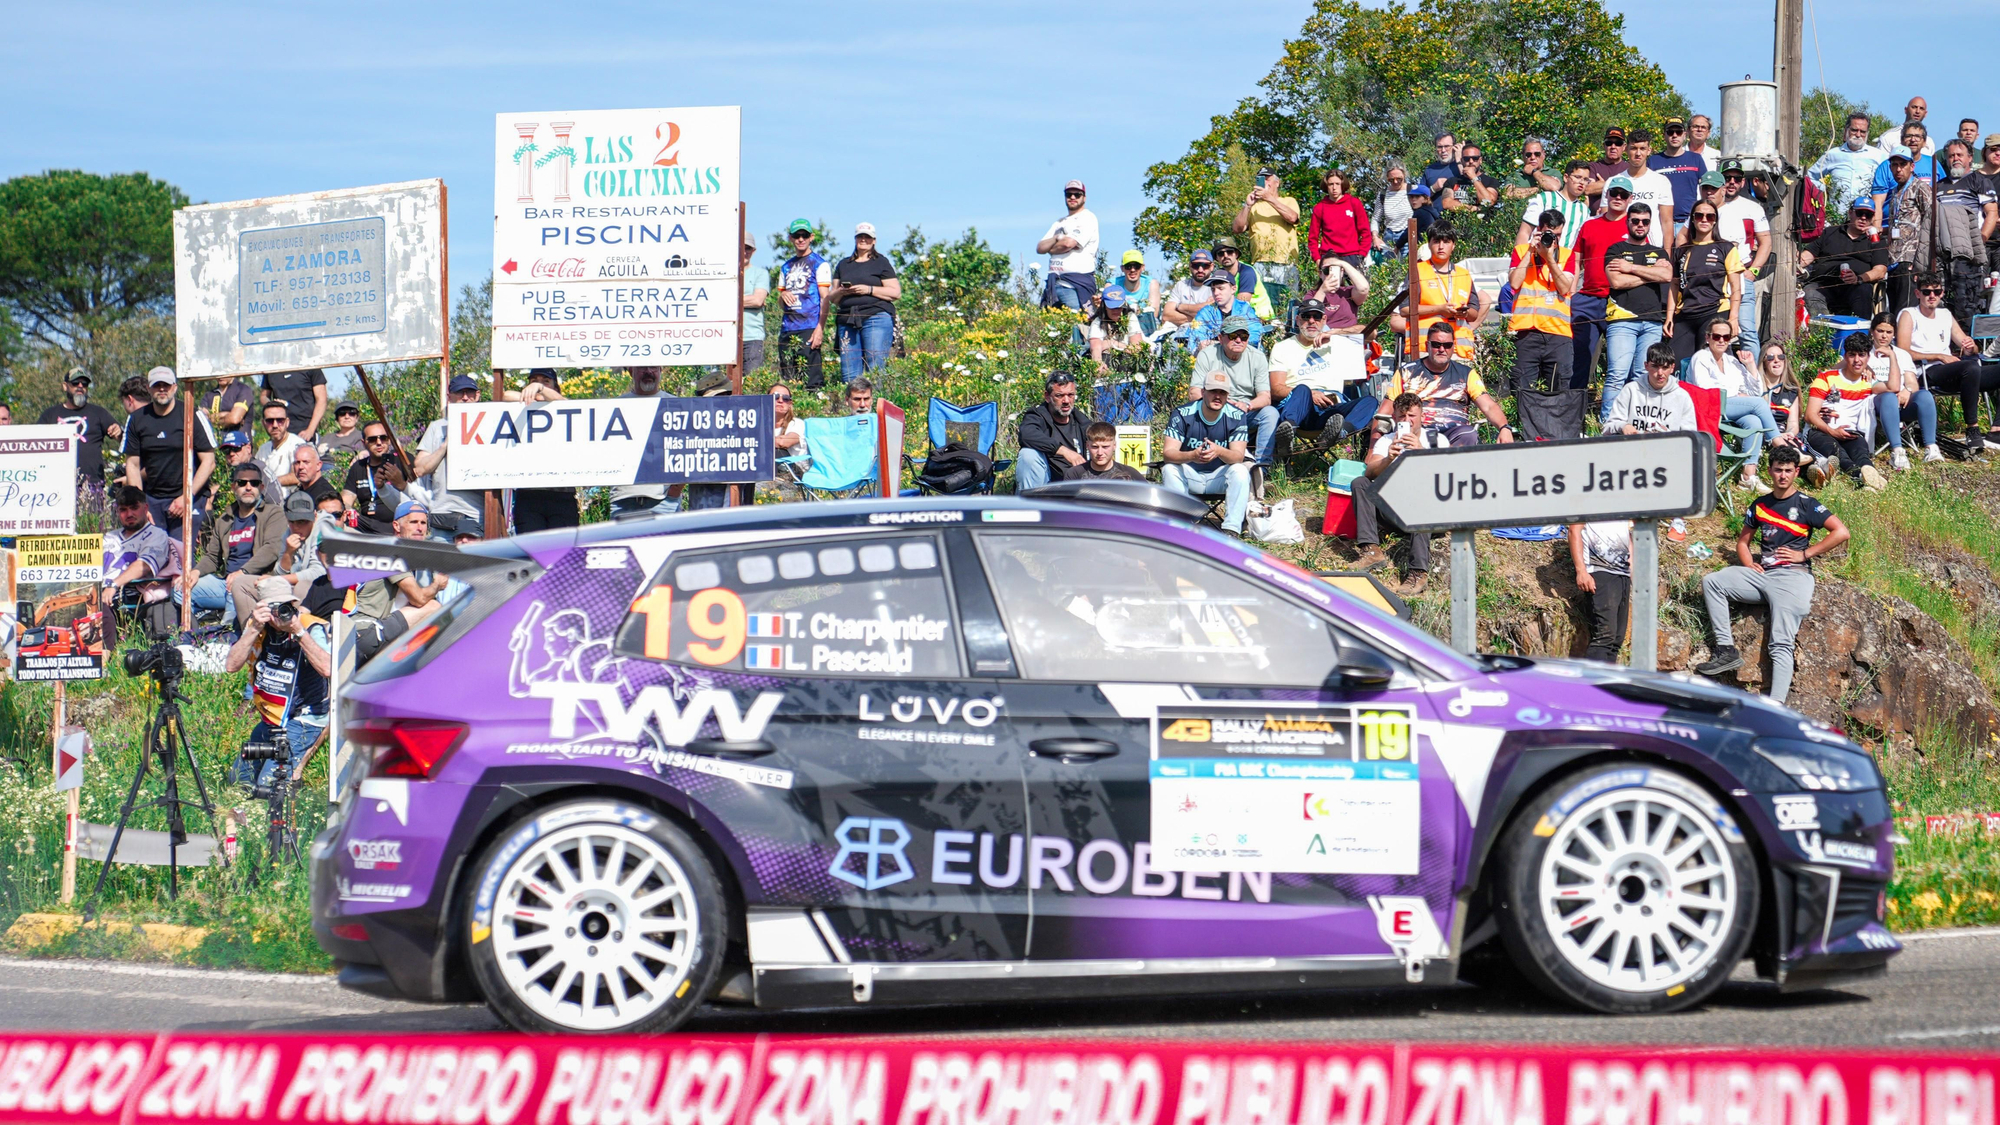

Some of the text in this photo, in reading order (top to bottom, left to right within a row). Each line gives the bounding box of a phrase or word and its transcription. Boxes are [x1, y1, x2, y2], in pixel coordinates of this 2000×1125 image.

[585, 122, 681, 166] LAS 2
[583, 167, 721, 198] COLUMNAS
[249, 236, 304, 252] EXCAVACIONES
[320, 228, 376, 245] TRANSPORTES
[541, 223, 690, 246] PISCINA
[285, 249, 362, 272] ZAMORA
[531, 256, 587, 279] Coca-Cola
[606, 256, 641, 264] CERVEZA
[598, 264, 649, 278] AGUILA
[253, 270, 371, 294] TLF: 957-723138
[248, 290, 376, 314] Móvil: 659-362215
[522, 290, 565, 305] PUB
[602, 287, 709, 303] TERRAZA
[355, 314, 379, 324] kms.
[533, 303, 698, 321] RESTAURANTE
[505, 328, 723, 342] MATERIALES DE CONSTRUCCION
[580, 345, 611, 358] 957
[620, 344, 651, 357] 723
[660, 343, 693, 356] 037
[663, 408, 757, 431] 957 03 64 89
[1635, 405, 1672, 421] ROCKY
[460, 407, 633, 446] KAPTIA
[664, 435, 758, 450] Más información en:
[663, 448, 757, 477] kaptia.net
[1434, 462, 1667, 501] Urb. Las Jaras
[20, 519, 33, 530] DE
[35, 519, 70, 529] MONTE
[869, 511, 964, 526] SIMUMOTION
[20, 538, 100, 553] RETROEXCAVADORA
[27, 551, 92, 566] CAMIÓN PLUMA
[20, 568, 98, 581] 663 722 546
[631, 585, 748, 667] 19
[784, 612, 948, 643] T. Charpentier
[25, 656, 93, 669] TRABAJOS EN ALTURA
[785, 644, 913, 674] L. Pascaud
[18, 668, 100, 680] TODO TIPO DE TRANSPORTE
[858, 727, 996, 747] ELEGANCE IN EVERY SMILE
[1161, 718, 1212, 742] 43
[1212, 720, 1264, 733] RALLY
[1359, 710, 1411, 760] 19
[615, 746, 637, 759] TO
[351, 884, 413, 898] MICHELIN
[1393, 910, 1413, 936] E
[142, 1043, 278, 1118] ZONA
[278, 1044, 538, 1122] PROHIBIDO
[536, 1048, 747, 1125] PUBLICO
[750, 1049, 887, 1125] ZONA
[898, 1050, 1164, 1125] PROHIBIDO
[1407, 1056, 1544, 1125] ZONA
[1566, 1057, 1849, 1125] PROHIBIDO
